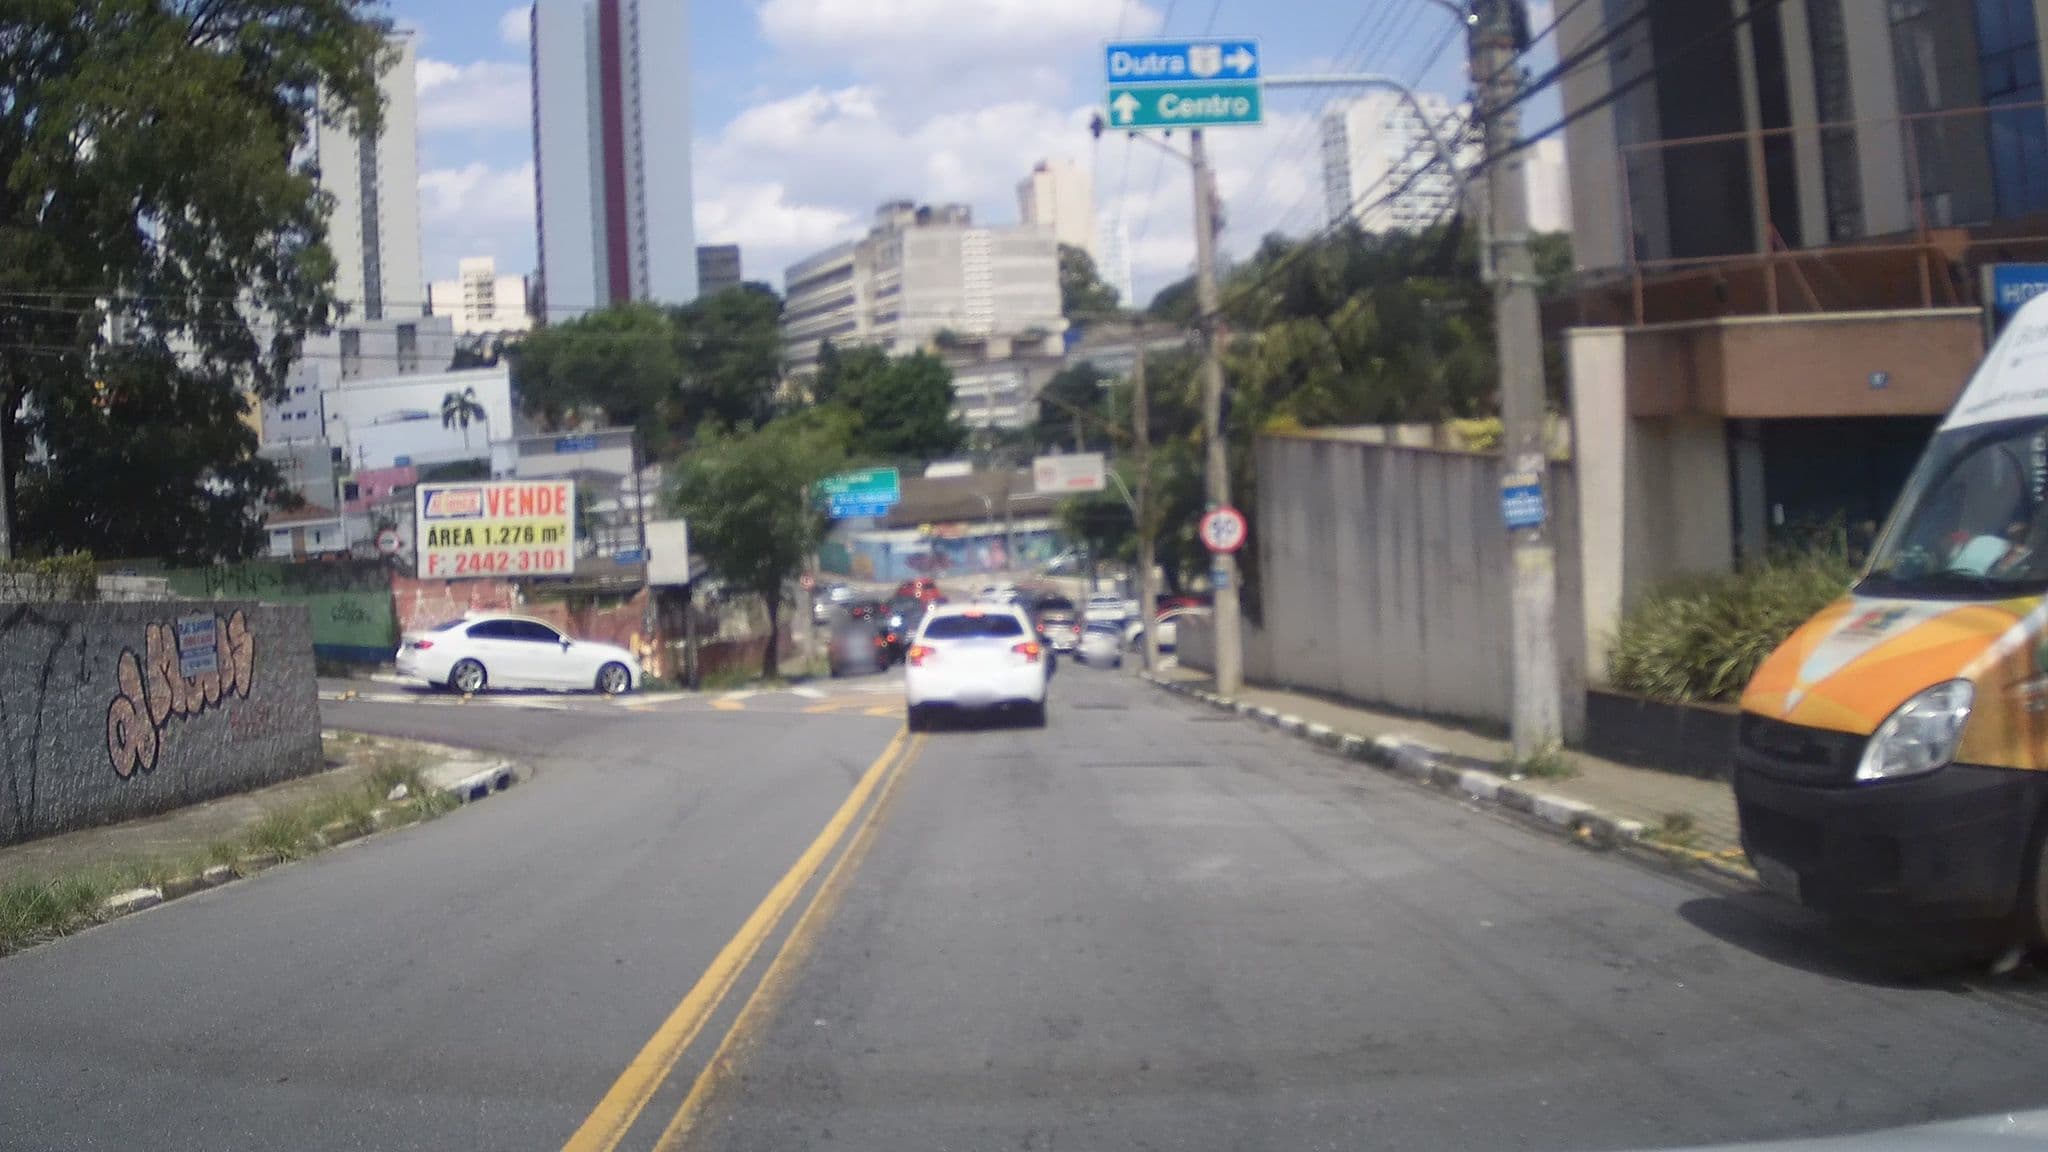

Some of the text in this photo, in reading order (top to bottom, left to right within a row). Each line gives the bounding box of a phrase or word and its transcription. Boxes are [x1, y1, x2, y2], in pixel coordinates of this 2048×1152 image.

[1111, 51, 1185, 76] Dutra
[1158, 93, 1250, 118] Centro
[488, 486, 567, 517] VENDE
[428, 524, 474, 547] ÁREA
[455, 549, 565, 574] 2442-3101
